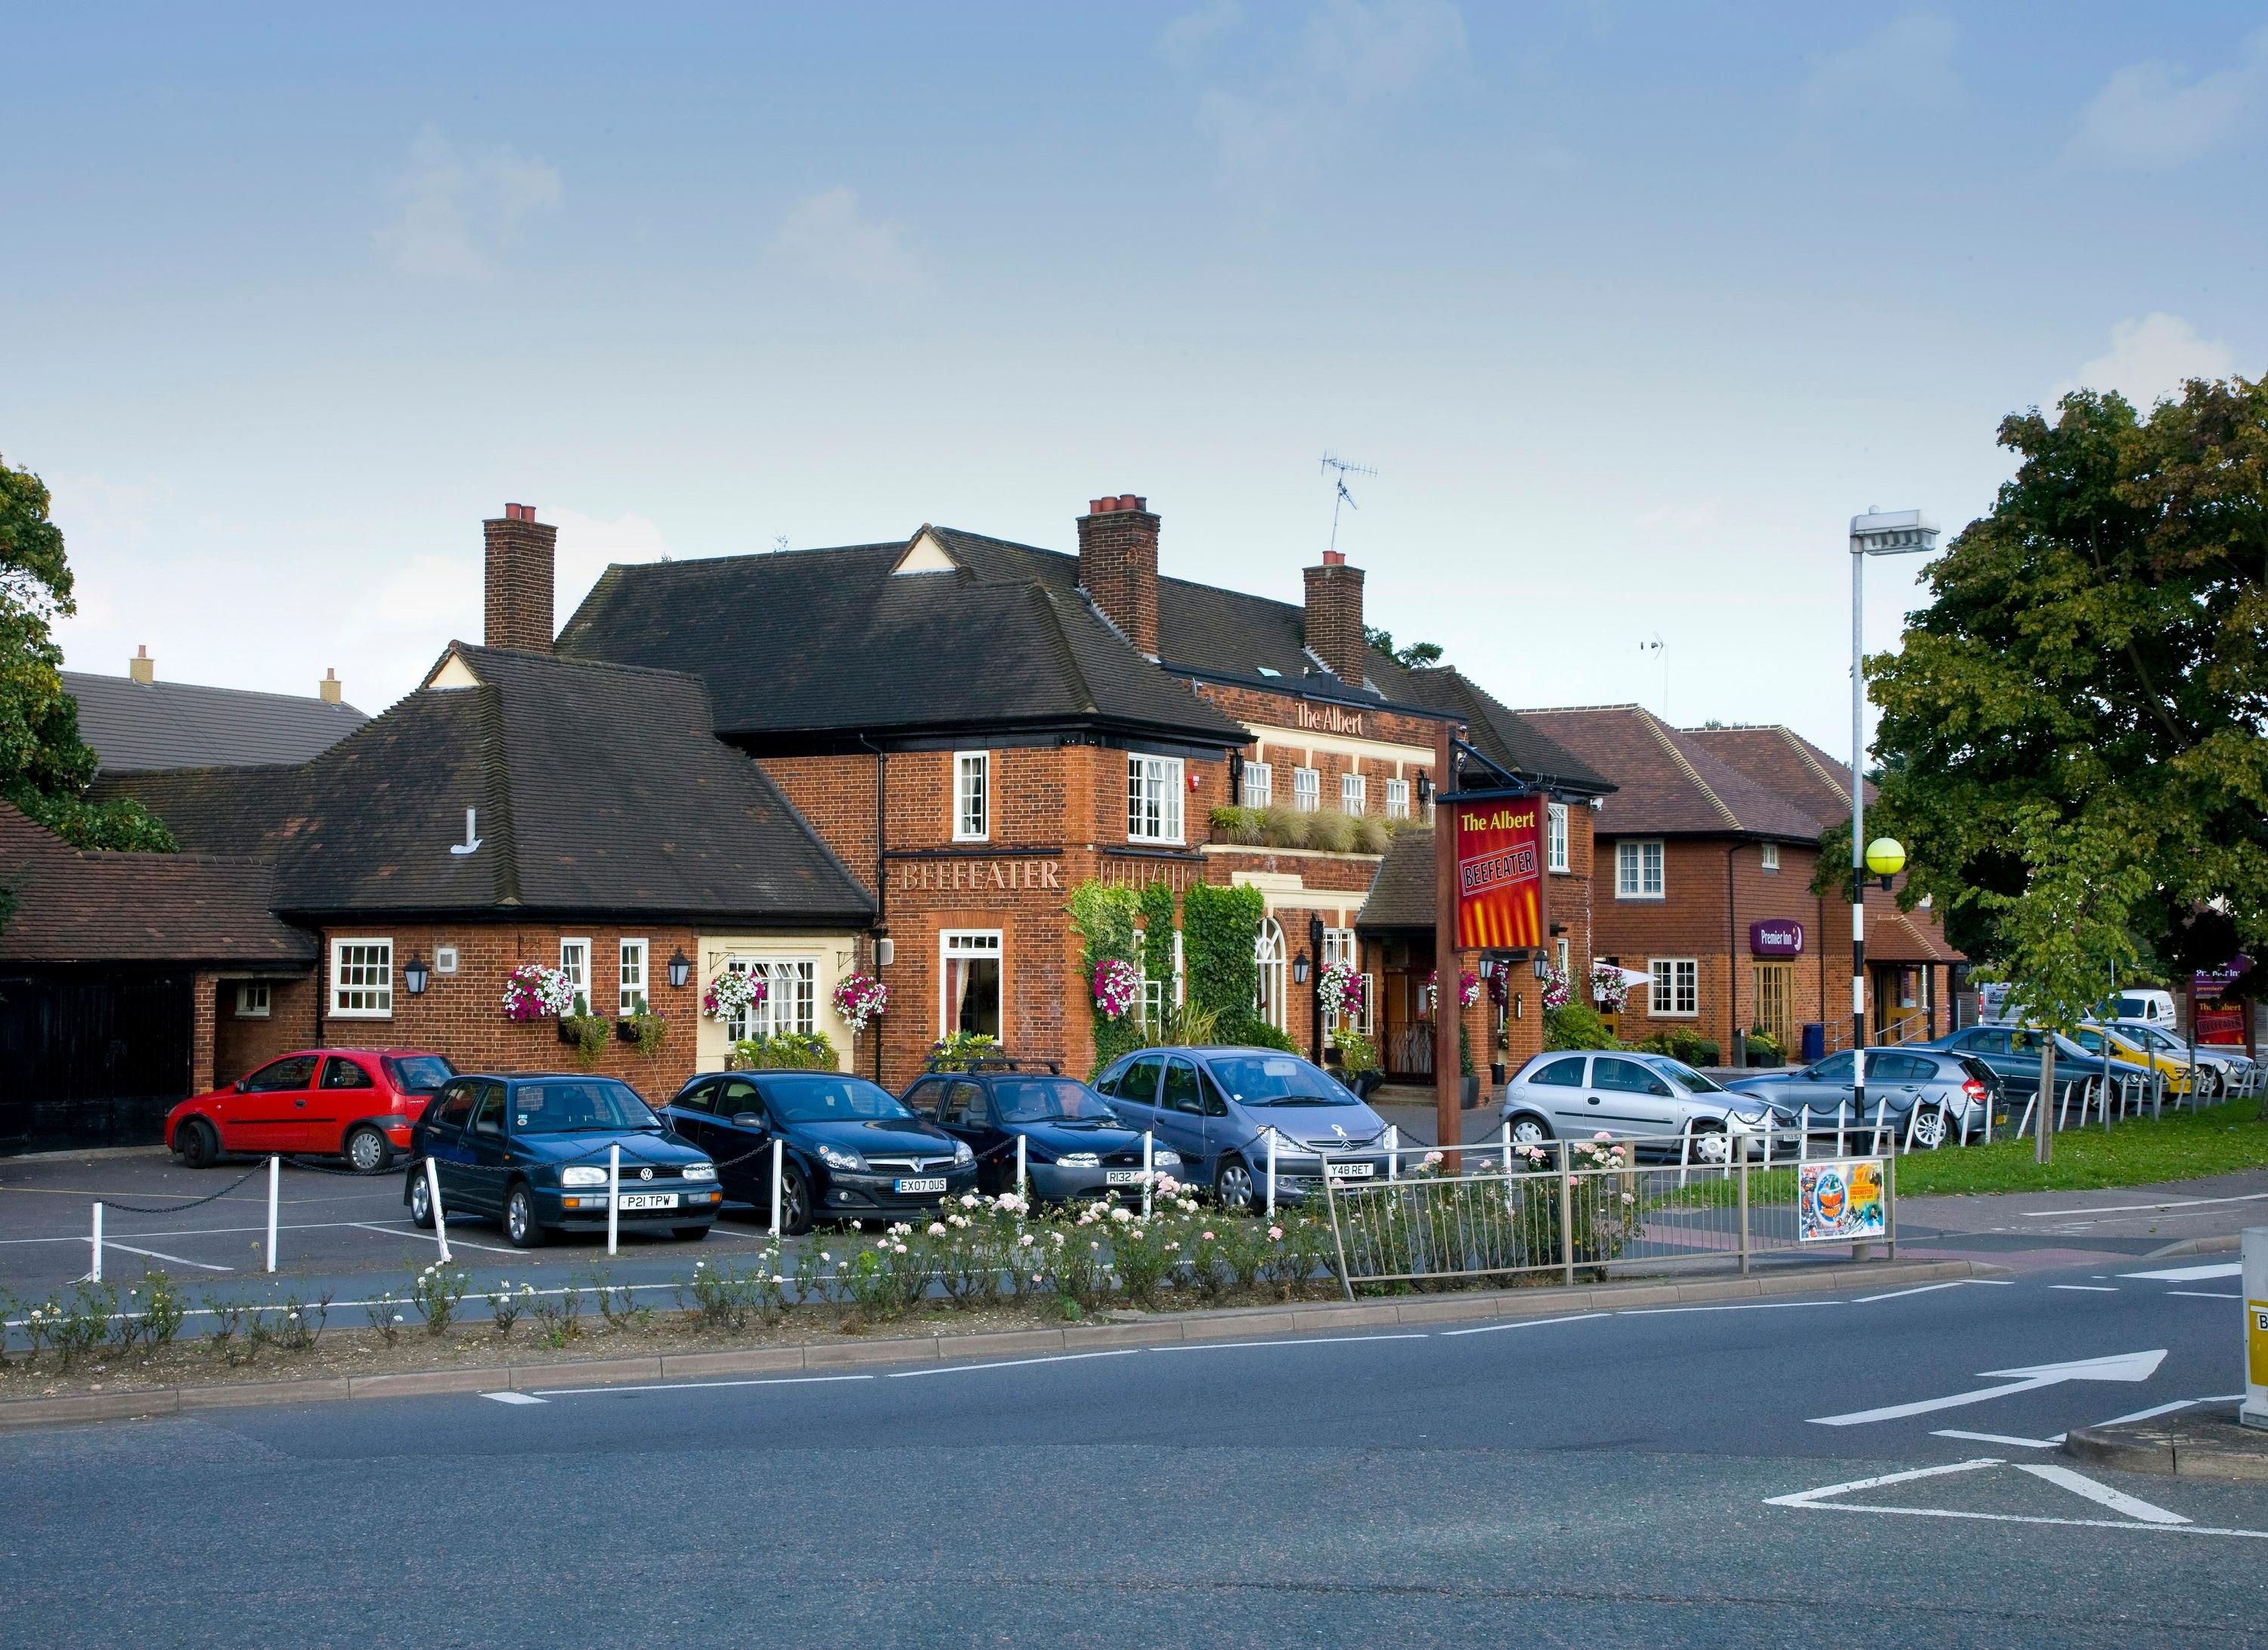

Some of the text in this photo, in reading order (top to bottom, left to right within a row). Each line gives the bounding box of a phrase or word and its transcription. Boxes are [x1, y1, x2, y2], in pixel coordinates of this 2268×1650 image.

[1295, 702, 1362, 735] The Albert
[1461, 811, 1535, 831] The Albert
[900, 861, 1060, 891] BEEFEATER
[1464, 850, 1533, 888] BEEFEATER
[1761, 929, 1792, 945] Premier Inn
[1109, 1172, 1131, 1182] R132
[1331, 1165, 1369, 1175] Y48 RET
[901, 1180, 944, 1191] EX07 OUS
[627, 1196, 671, 1207] P21 TPW
